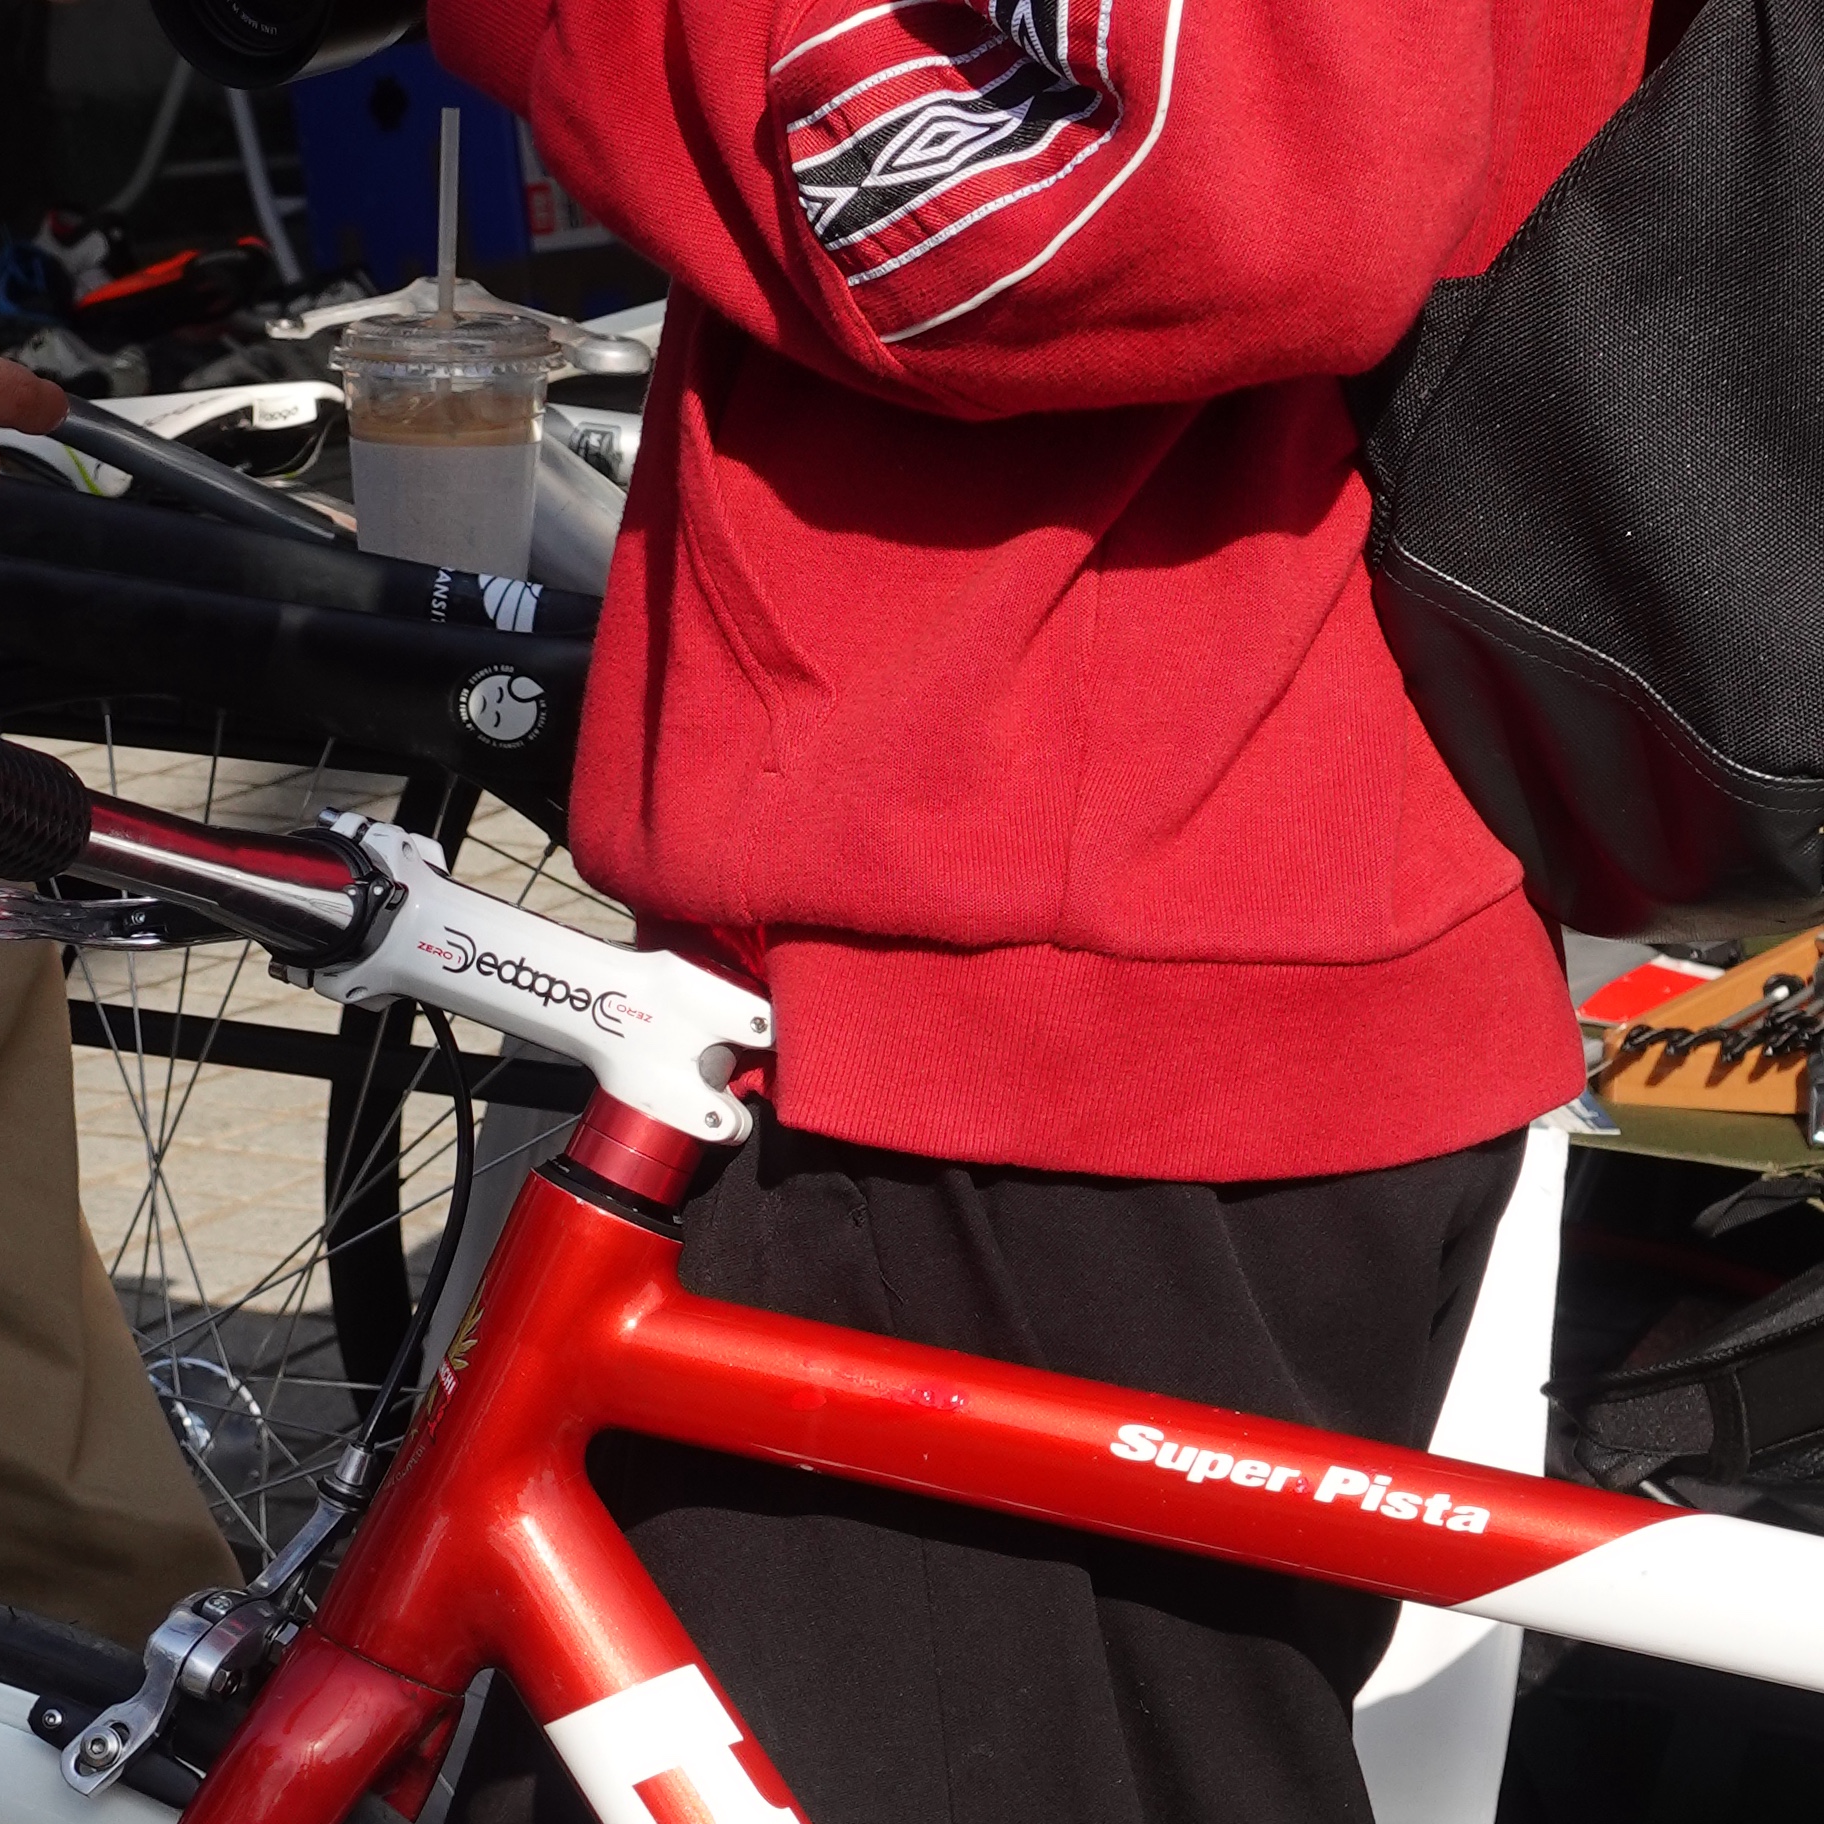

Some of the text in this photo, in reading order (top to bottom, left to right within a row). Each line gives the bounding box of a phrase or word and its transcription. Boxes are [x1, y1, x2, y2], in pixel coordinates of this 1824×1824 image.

[431, 566, 455, 623] ANSI
[417, 941, 453, 961] ZERO
[1110, 1422, 1491, 1535] Super Pista
